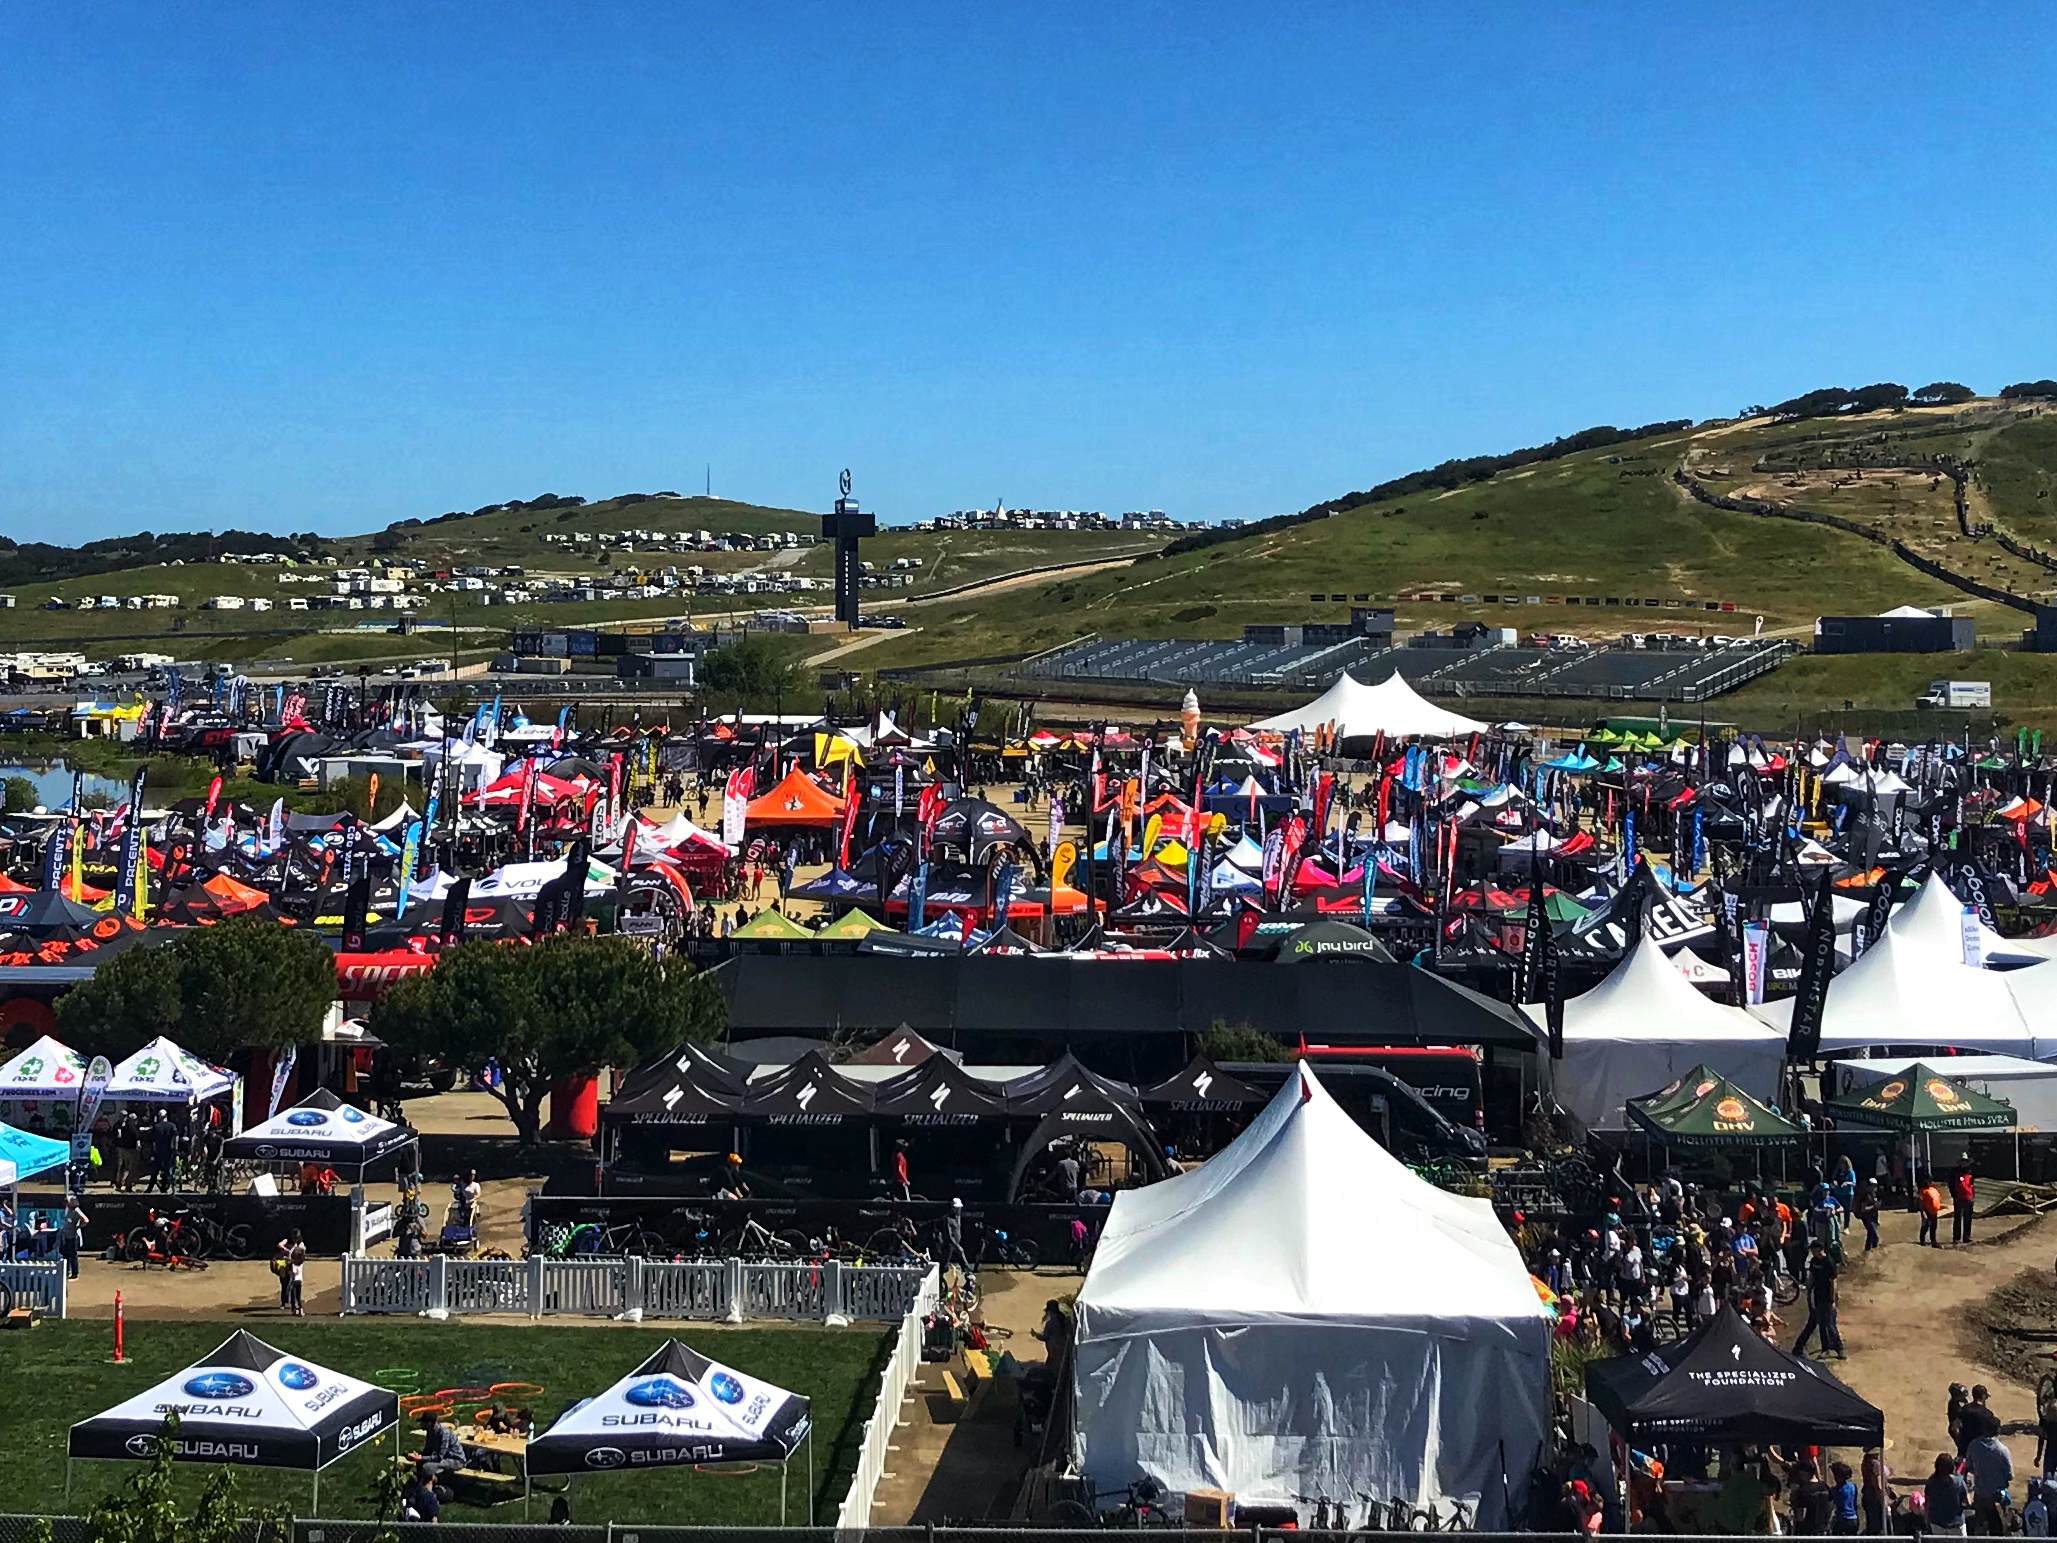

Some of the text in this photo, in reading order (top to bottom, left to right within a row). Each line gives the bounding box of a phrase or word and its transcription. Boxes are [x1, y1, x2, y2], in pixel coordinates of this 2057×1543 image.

[52, 829, 66, 889] PACENTI
[125, 827, 140, 887] PACENTI
[1749, 942, 1759, 992] BOSCH
[1169, 1100, 1242, 1111] SPECIALIZED
[631, 1112, 709, 1124] SPECIALIZED
[767, 1113, 843, 1124] SPECIALIZED
[903, 1114, 979, 1126] SPECIALIZED
[1061, 1112, 1113, 1121] SPECIALIZED
[1713, 1120, 1755, 1131] OHV
[270, 1128, 333, 1137] SUBARU
[279, 1148, 330, 1158] SUBARU
[1717, 1371, 1796, 1380] SPECIALIZED
[1704, 1378, 1785, 1386] FOUNDATION
[304, 1382, 349, 1412] SUBARU
[742, 1391, 771, 1425] SUBARU
[352, 1410, 383, 1440] SUBARU
[602, 1413, 712, 1430] SUBARU
[173, 1440, 258, 1458] SUBARU
[631, 1444, 723, 1462] SUBARU
